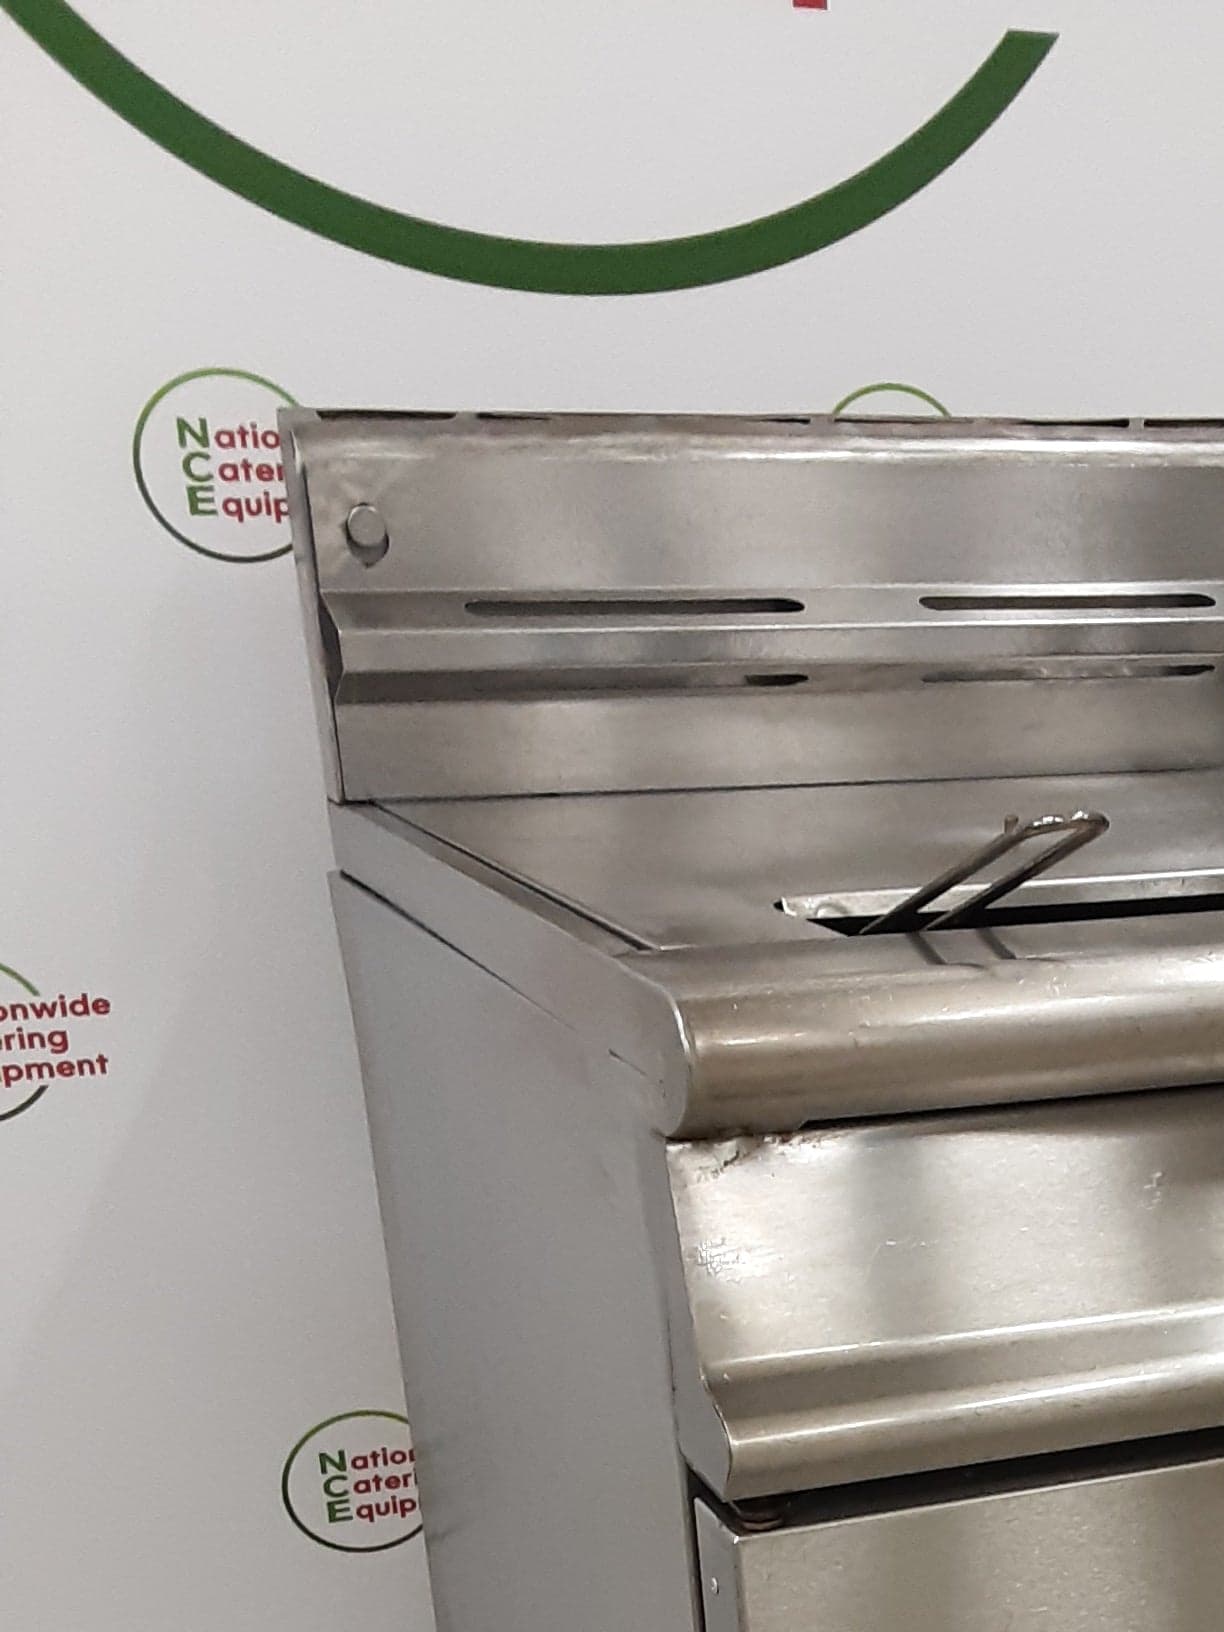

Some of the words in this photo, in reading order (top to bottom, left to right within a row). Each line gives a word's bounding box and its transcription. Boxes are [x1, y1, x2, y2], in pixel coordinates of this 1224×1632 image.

[176, 416, 281, 450] Natio
[182, 451, 285, 482] Cater
[186, 484, 290, 524] Equip
[0, 1026, 70, 1055] ring
[0, 1054, 109, 1088] pment
[318, 1446, 416, 1475] Natio
[326, 1494, 417, 1523] Equip
